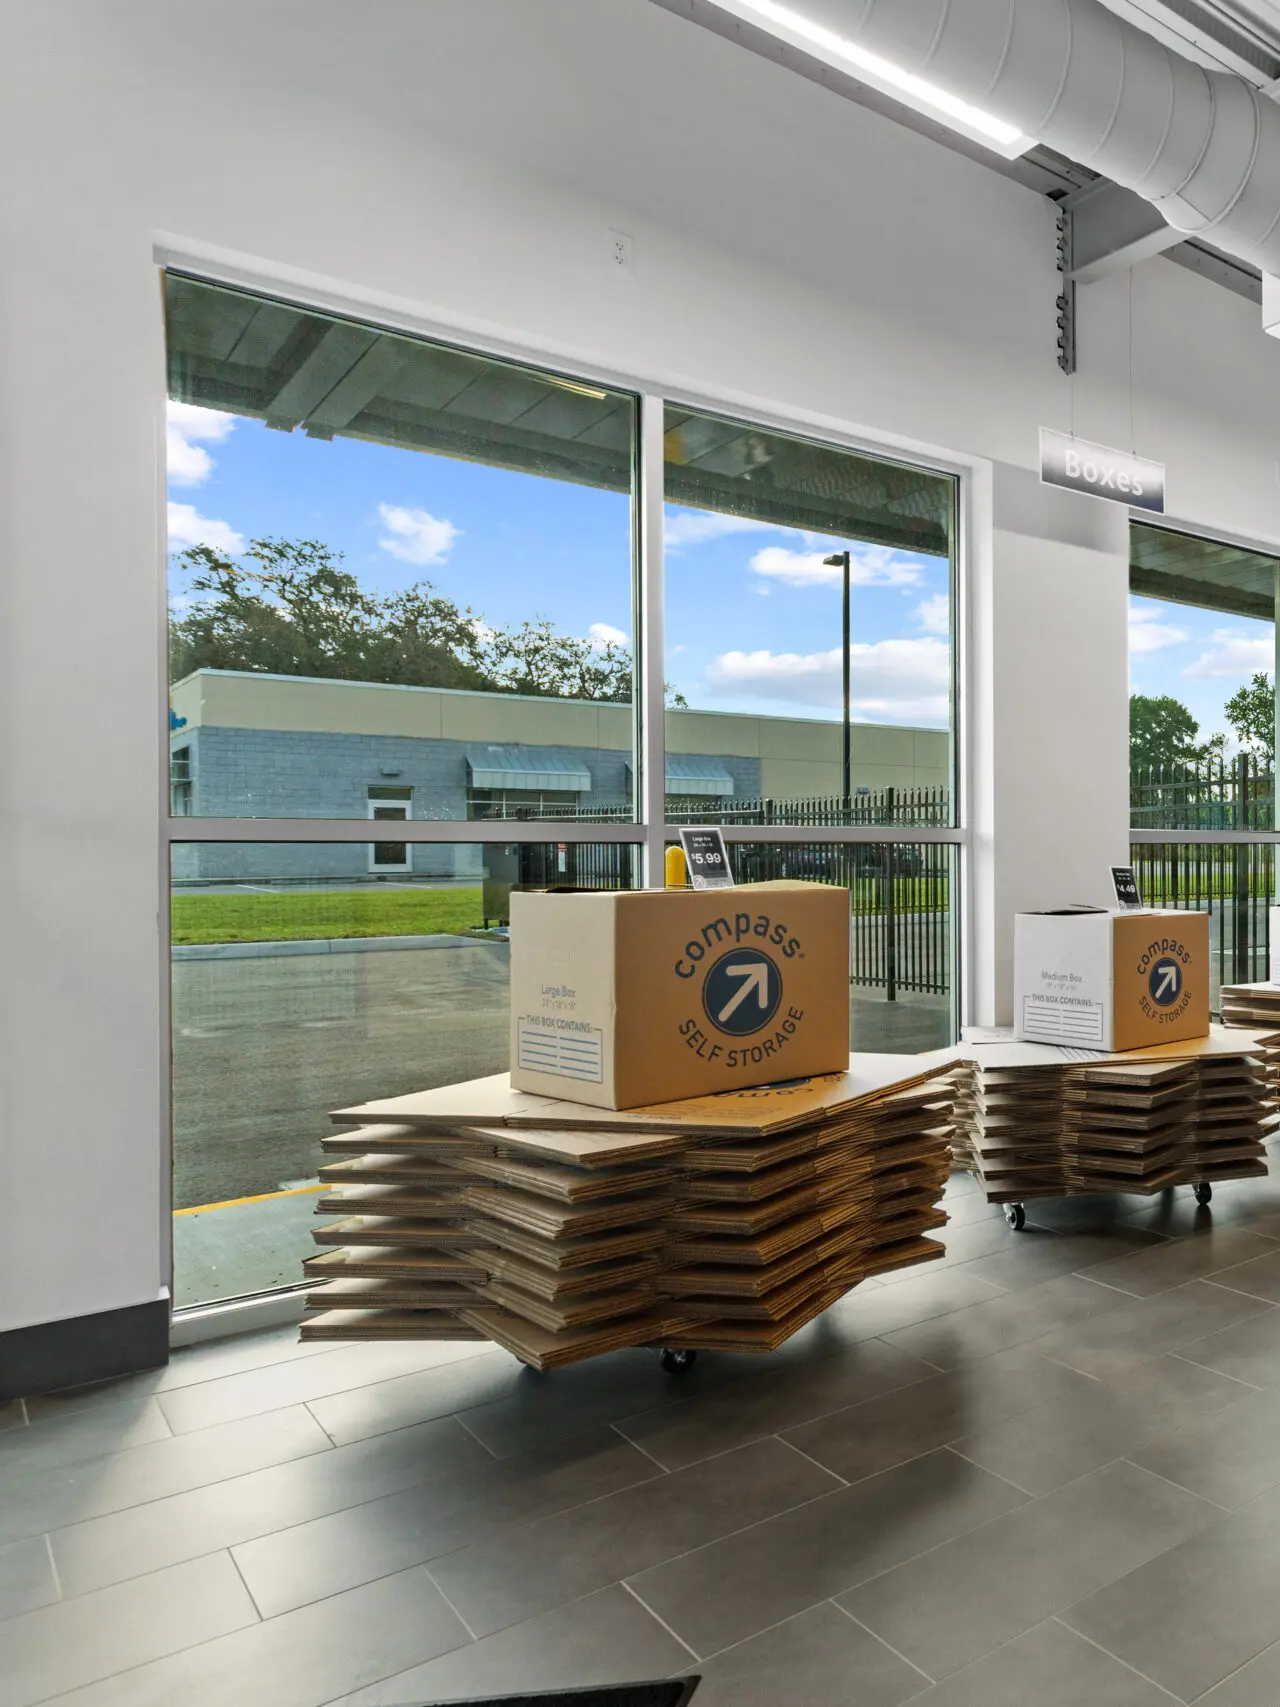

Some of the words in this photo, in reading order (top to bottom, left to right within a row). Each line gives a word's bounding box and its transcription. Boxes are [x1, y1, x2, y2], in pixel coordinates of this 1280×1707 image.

[1064, 449, 1144, 496] Boxes
[690, 852, 721, 864] $5.99
[1116, 884, 1136, 893] $4.49
[674, 912, 802, 980] compass
[1137, 938, 1191, 975] compass
[1041, 971, 1068, 981] Medium
[1069, 973, 1083, 982] Box
[541, 983, 560, 998] Large
[561, 984, 576, 998] Box
[1032, 993, 1045, 1002] THIS
[1045, 994, 1059, 1004] BOX
[1060, 996, 1094, 1007] CONTAINS:
[1138, 995, 1158, 1021] SELF
[1158, 990, 1192, 1024] STORAGE
[526, 1014, 541, 1026] THIS
[541, 1017, 556, 1028] BOX
[556, 1018, 594, 1034] CONTAINS:
[678, 1017, 724, 1067] SELF
[726, 1006, 805, 1068] STORAGE
